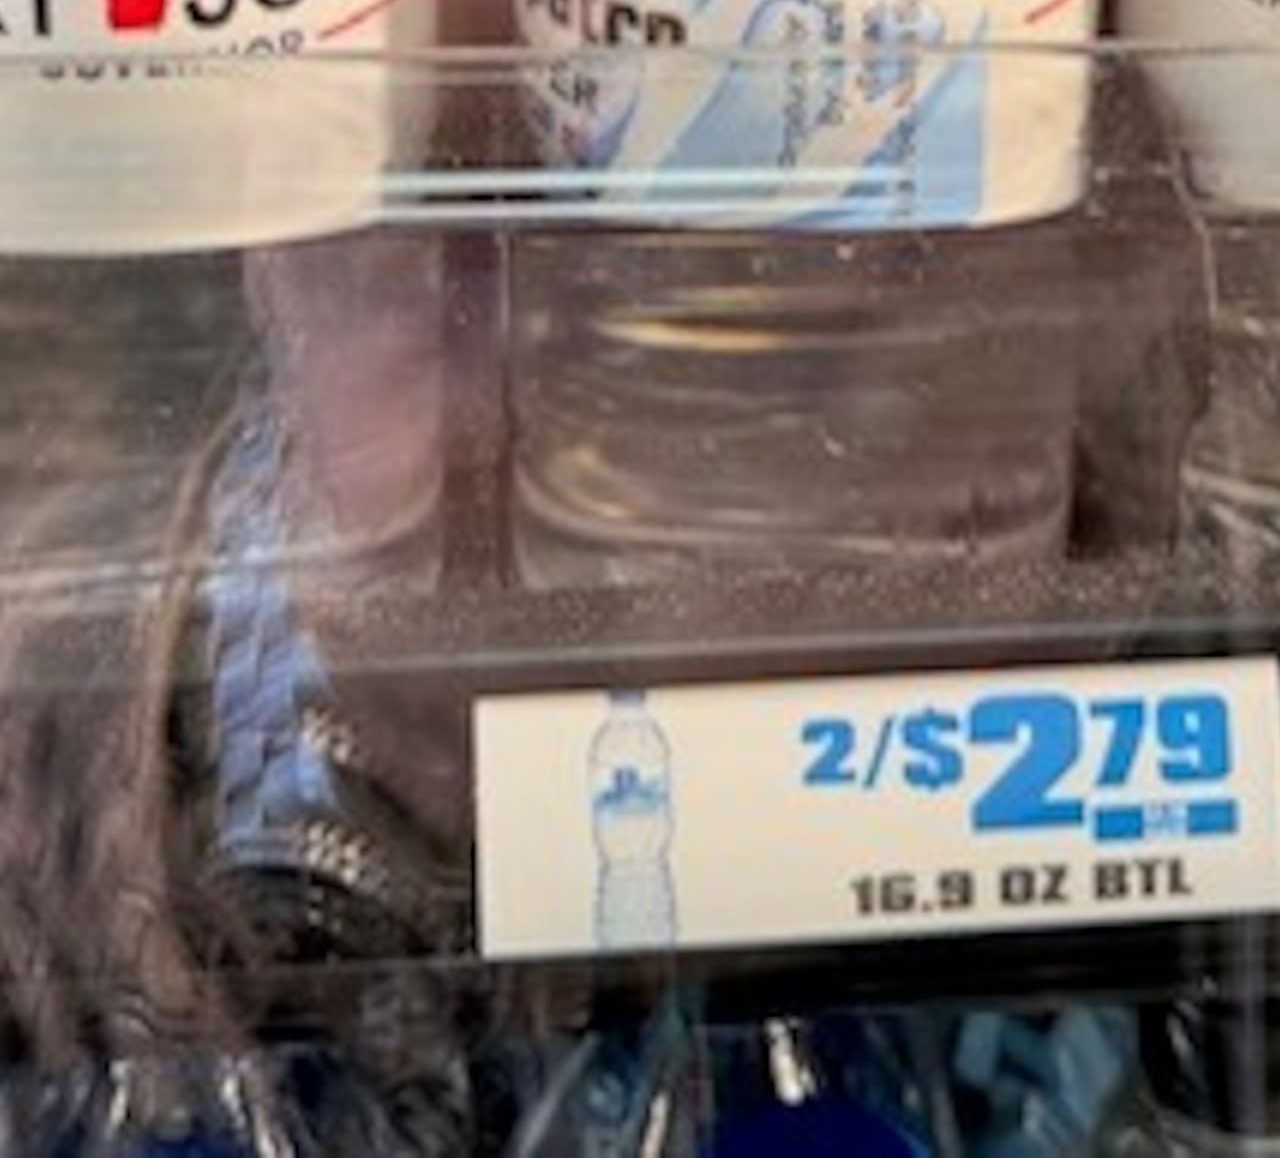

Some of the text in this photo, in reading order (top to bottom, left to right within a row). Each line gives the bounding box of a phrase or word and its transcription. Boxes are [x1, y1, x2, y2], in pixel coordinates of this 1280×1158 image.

[850, 854, 1196, 919] 16.9 OZ BTL
